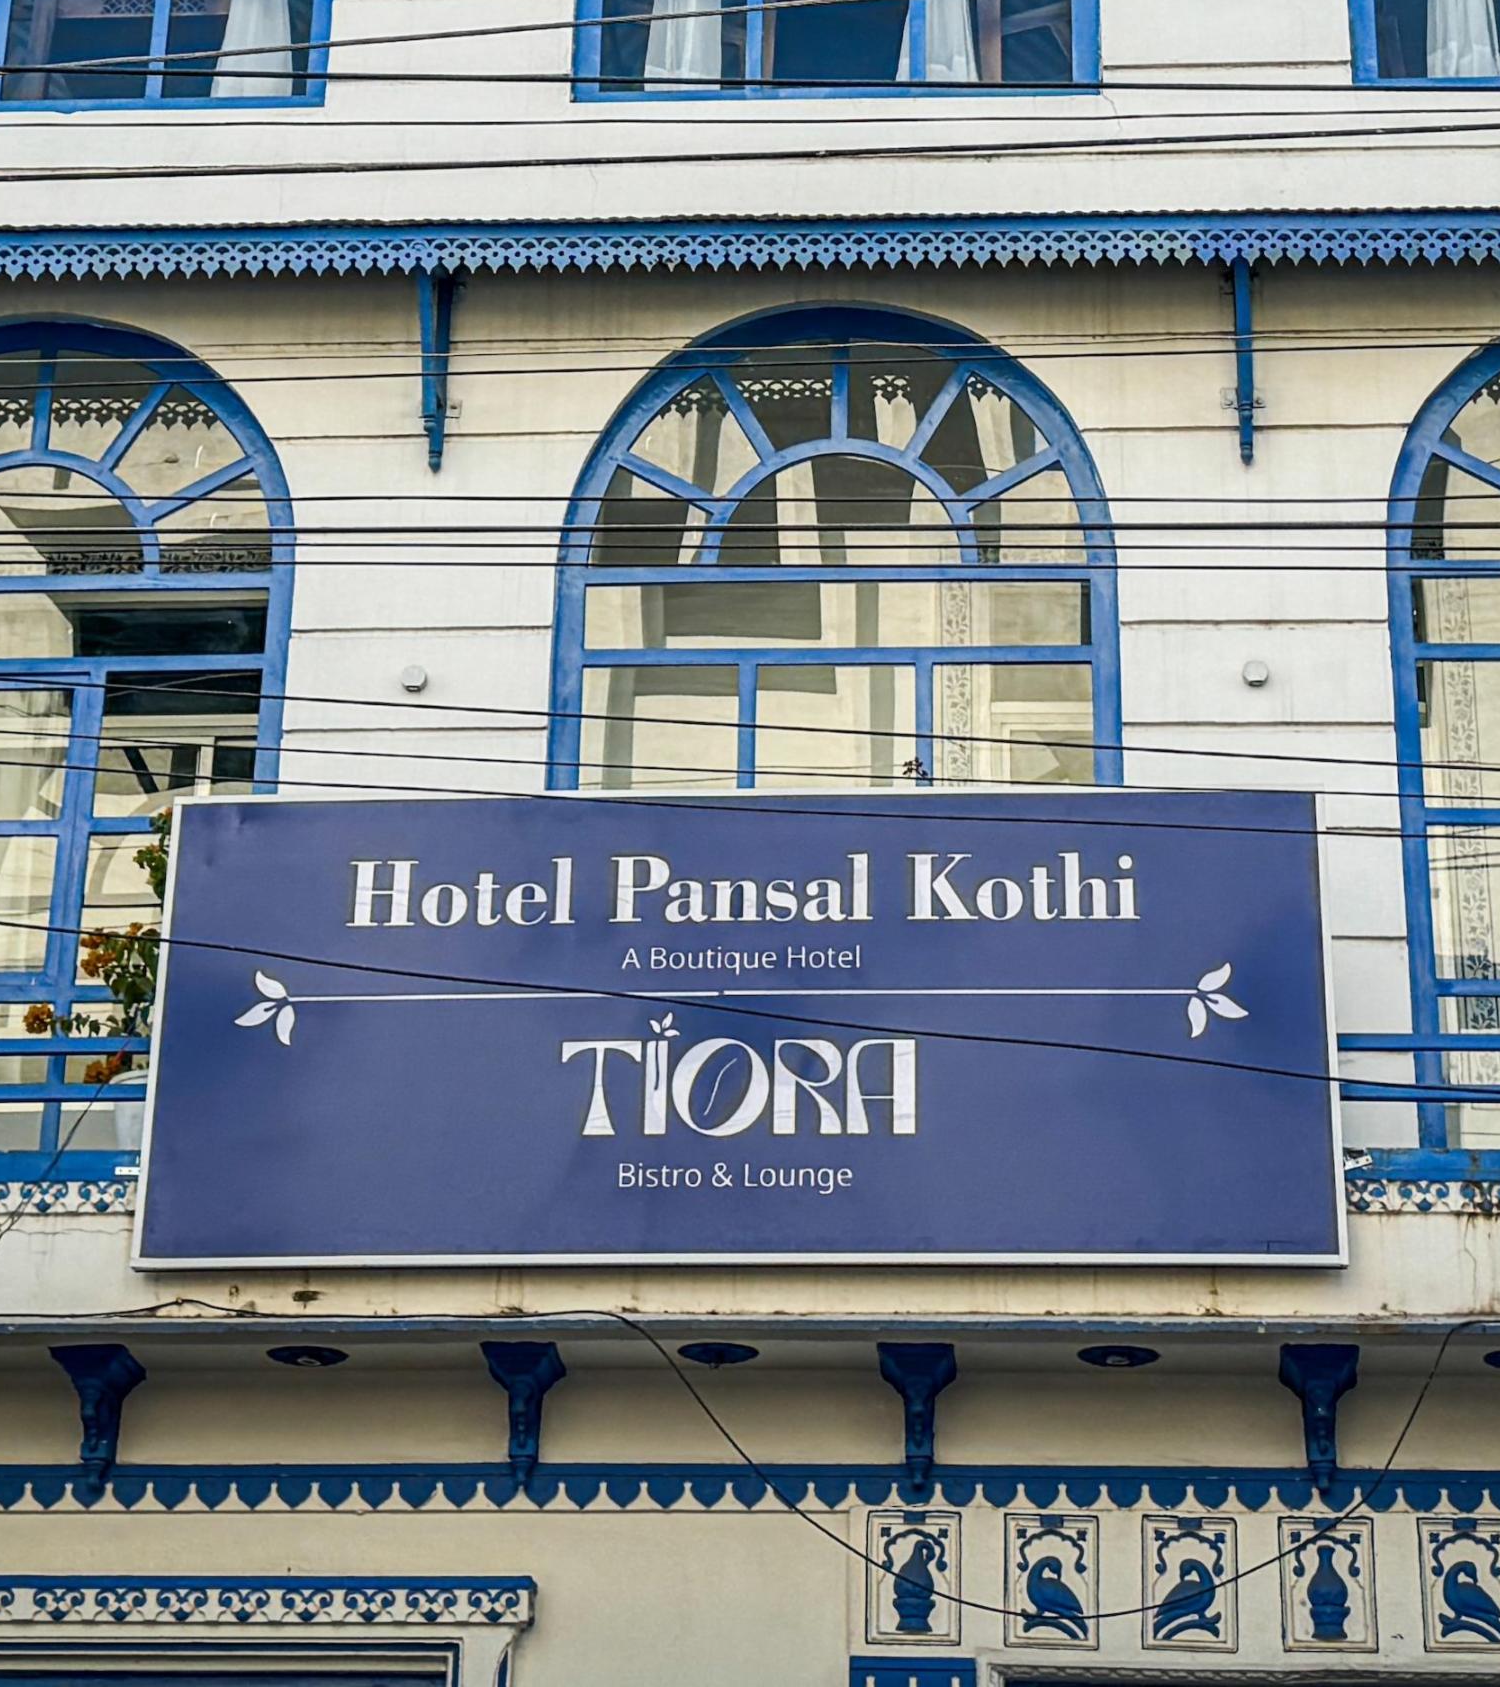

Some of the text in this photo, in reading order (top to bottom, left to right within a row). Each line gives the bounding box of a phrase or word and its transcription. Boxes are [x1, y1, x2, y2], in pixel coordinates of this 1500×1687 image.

[345, 851, 1141, 927] Hotel Pansal Kothi
[621, 944, 861, 976] A Boutique Hotel
[561, 1037, 917, 1137] TIORA
[618, 1162, 853, 1195] Bistro & Lounge
